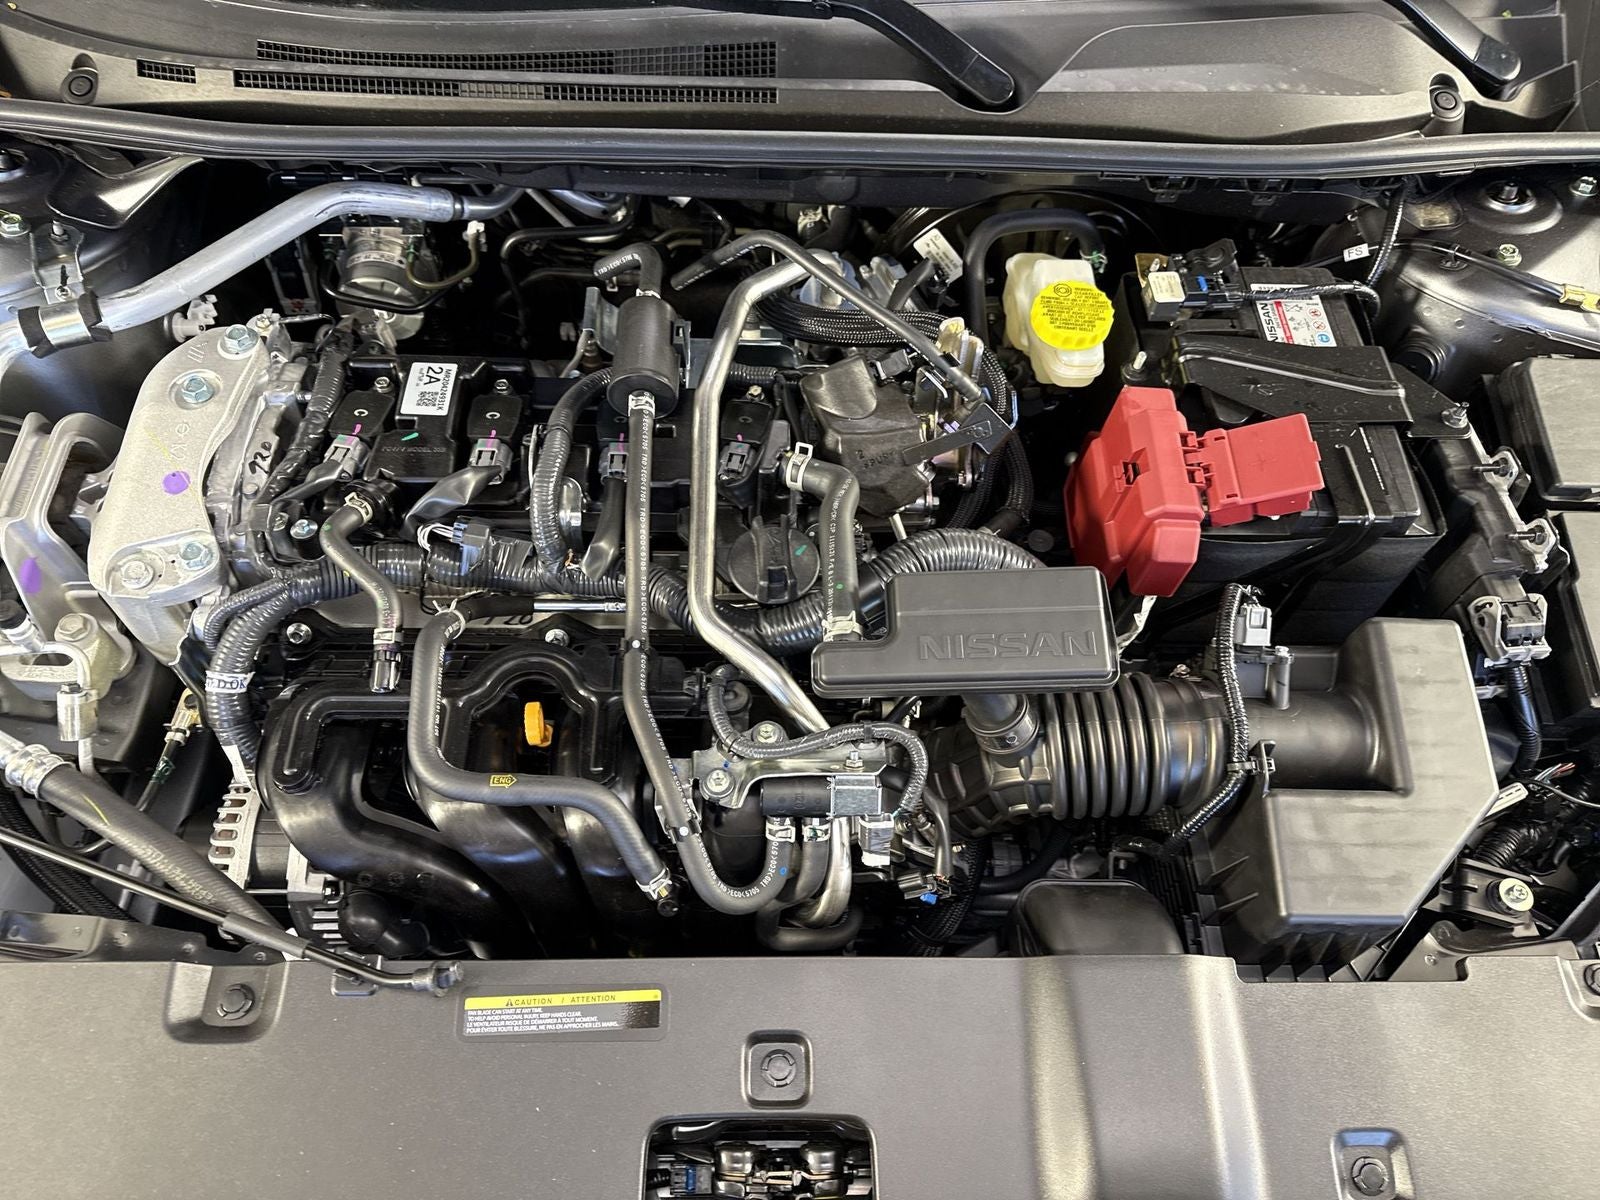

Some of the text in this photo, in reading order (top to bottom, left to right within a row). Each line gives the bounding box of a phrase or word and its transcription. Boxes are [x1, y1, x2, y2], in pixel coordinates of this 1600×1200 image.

[1348, 246, 1363, 258] FS
[1260, 302, 1279, 342] NISSAN
[423, 366, 444, 386] 2A
[918, 631, 1098, 660] NISSAN
[493, 776, 512, 785] ENG
[760, 841, 779, 889] TRD>ECO<570
[570, 995, 616, 1003] ATTENTION
